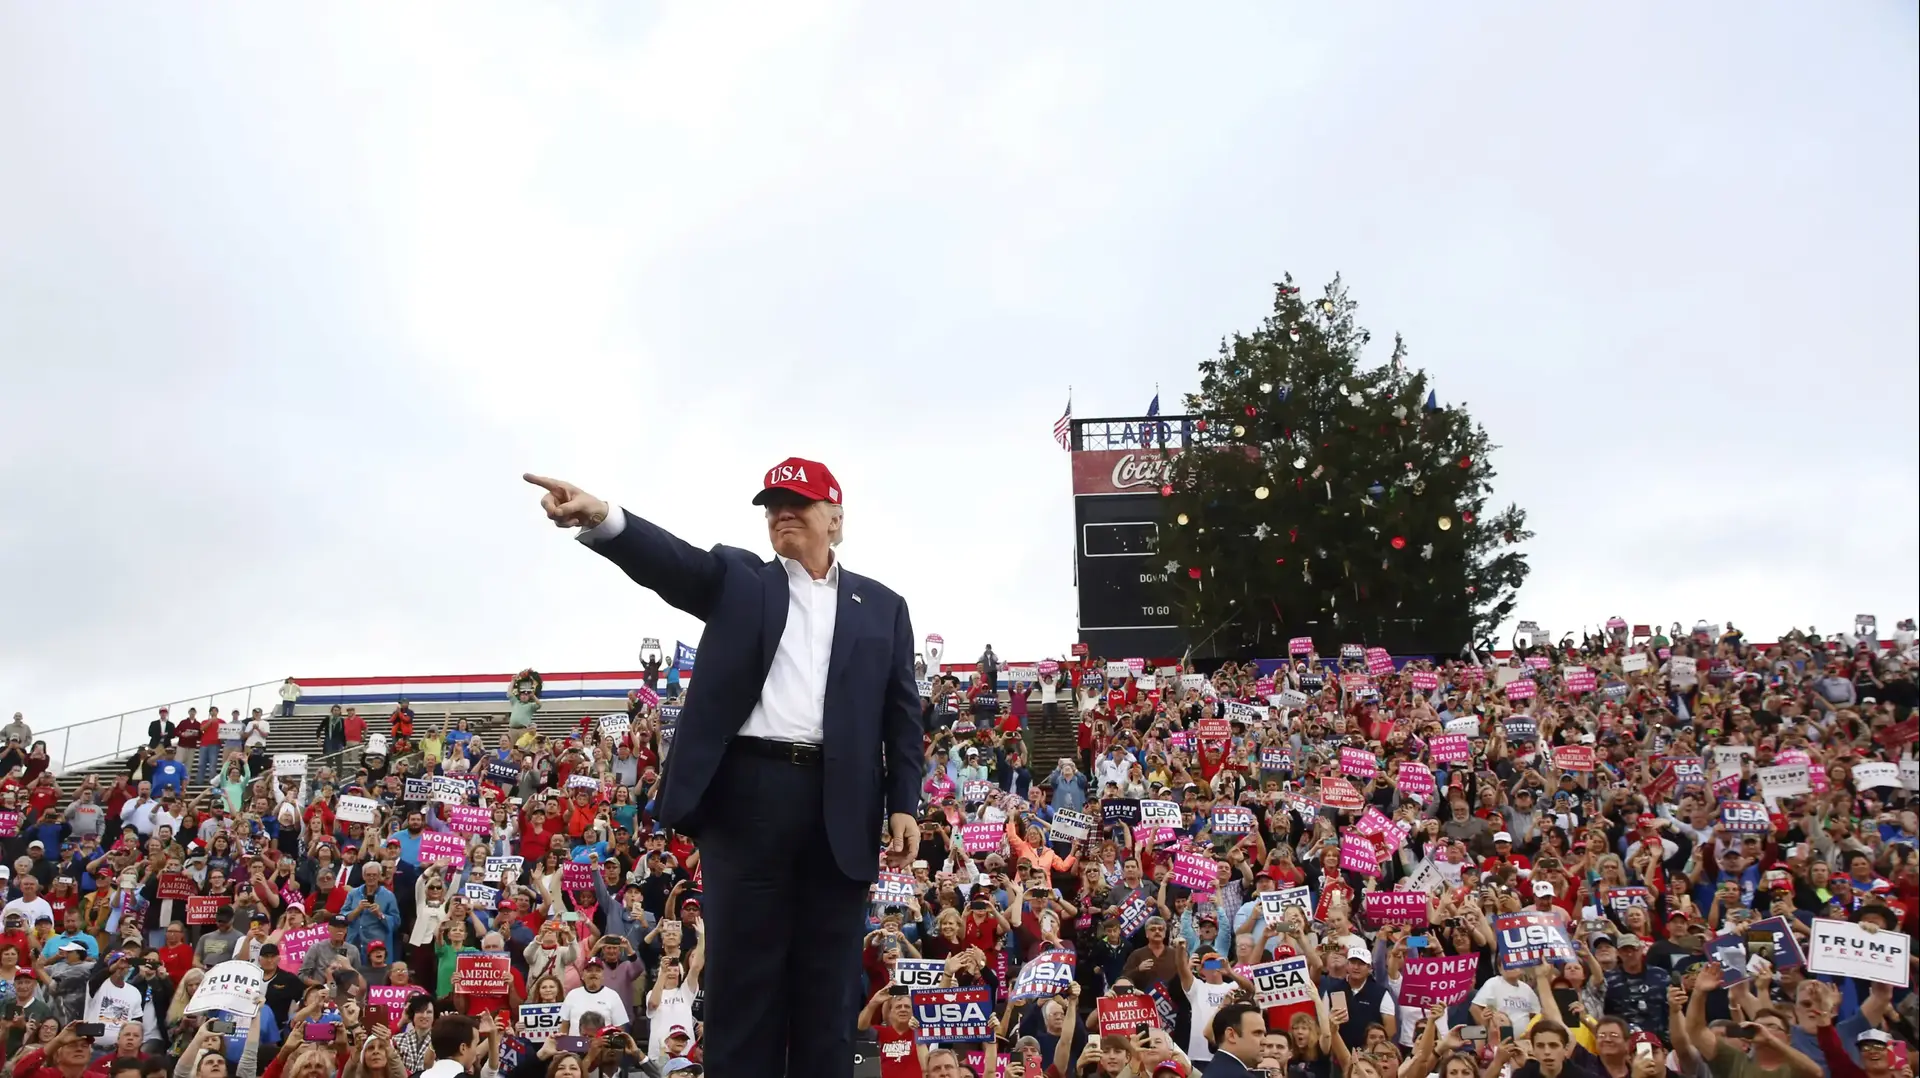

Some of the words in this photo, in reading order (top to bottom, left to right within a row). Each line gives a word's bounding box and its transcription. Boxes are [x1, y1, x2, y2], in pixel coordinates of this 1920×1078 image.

[1106, 422, 1172, 444] LADD
[771, 466, 808, 484] USA
[1142, 607, 1153, 615] TO
[1156, 606, 1169, 615] GO
[1368, 656, 1391, 666] WOMEN
[1232, 708, 1253, 716] USA
[602, 718, 627, 726] USA
[1429, 736, 1467, 746] WOMEN
[1263, 754, 1291, 764] USA
[1342, 750, 1376, 760] WOMEN
[1433, 751, 1467, 760] TRUMP
[489, 764, 519, 774] TRUMP
[1342, 765, 1374, 776] TRUMP
[1762, 771, 1805, 782] TRUMP
[1400, 782, 1433, 791] TRUMP
[1712, 775, 1740, 791] OMEN
[433, 783, 461, 795] USA
[964, 785, 989, 794] USA
[342, 801, 373, 810] TRUMP
[452, 806, 492, 817] WOMEN
[1059, 809, 1077, 817] SUCK
[1145, 807, 1178, 817] USA
[1725, 809, 1769, 821] USA
[1215, 814, 1250, 824] USA
[1368, 807, 1406, 841] WOMEN
[452, 823, 488, 832] TRUMP
[422, 833, 466, 846] WOMEN
[1345, 835, 1374, 851] WOME
[1356, 850, 1370, 859] FOR
[563, 862, 604, 870] WOMN
[1177, 854, 1218, 872] WOMEN
[1188, 867, 1204, 876] FOR
[160, 882, 192, 890] AMERIC
[876, 882, 914, 895] USA
[1368, 895, 1426, 905] WOMEN
[1371, 917, 1424, 926] TRUMP
[1503, 926, 1566, 948] USA
[1819, 935, 1902, 955] TRUMP
[1824, 947, 1894, 963] PENCE
[1406, 957, 1479, 976] WOMEN
[1018, 960, 1073, 986] USA
[208, 974, 260, 987] RUMP
[1258, 971, 1305, 992] USA
[1430, 980, 1456, 990] FOR
[919, 1003, 986, 1022] USA
[1101, 1009, 1157, 1023] AMERICA
[1106, 1022, 1130, 1031] GREAT
